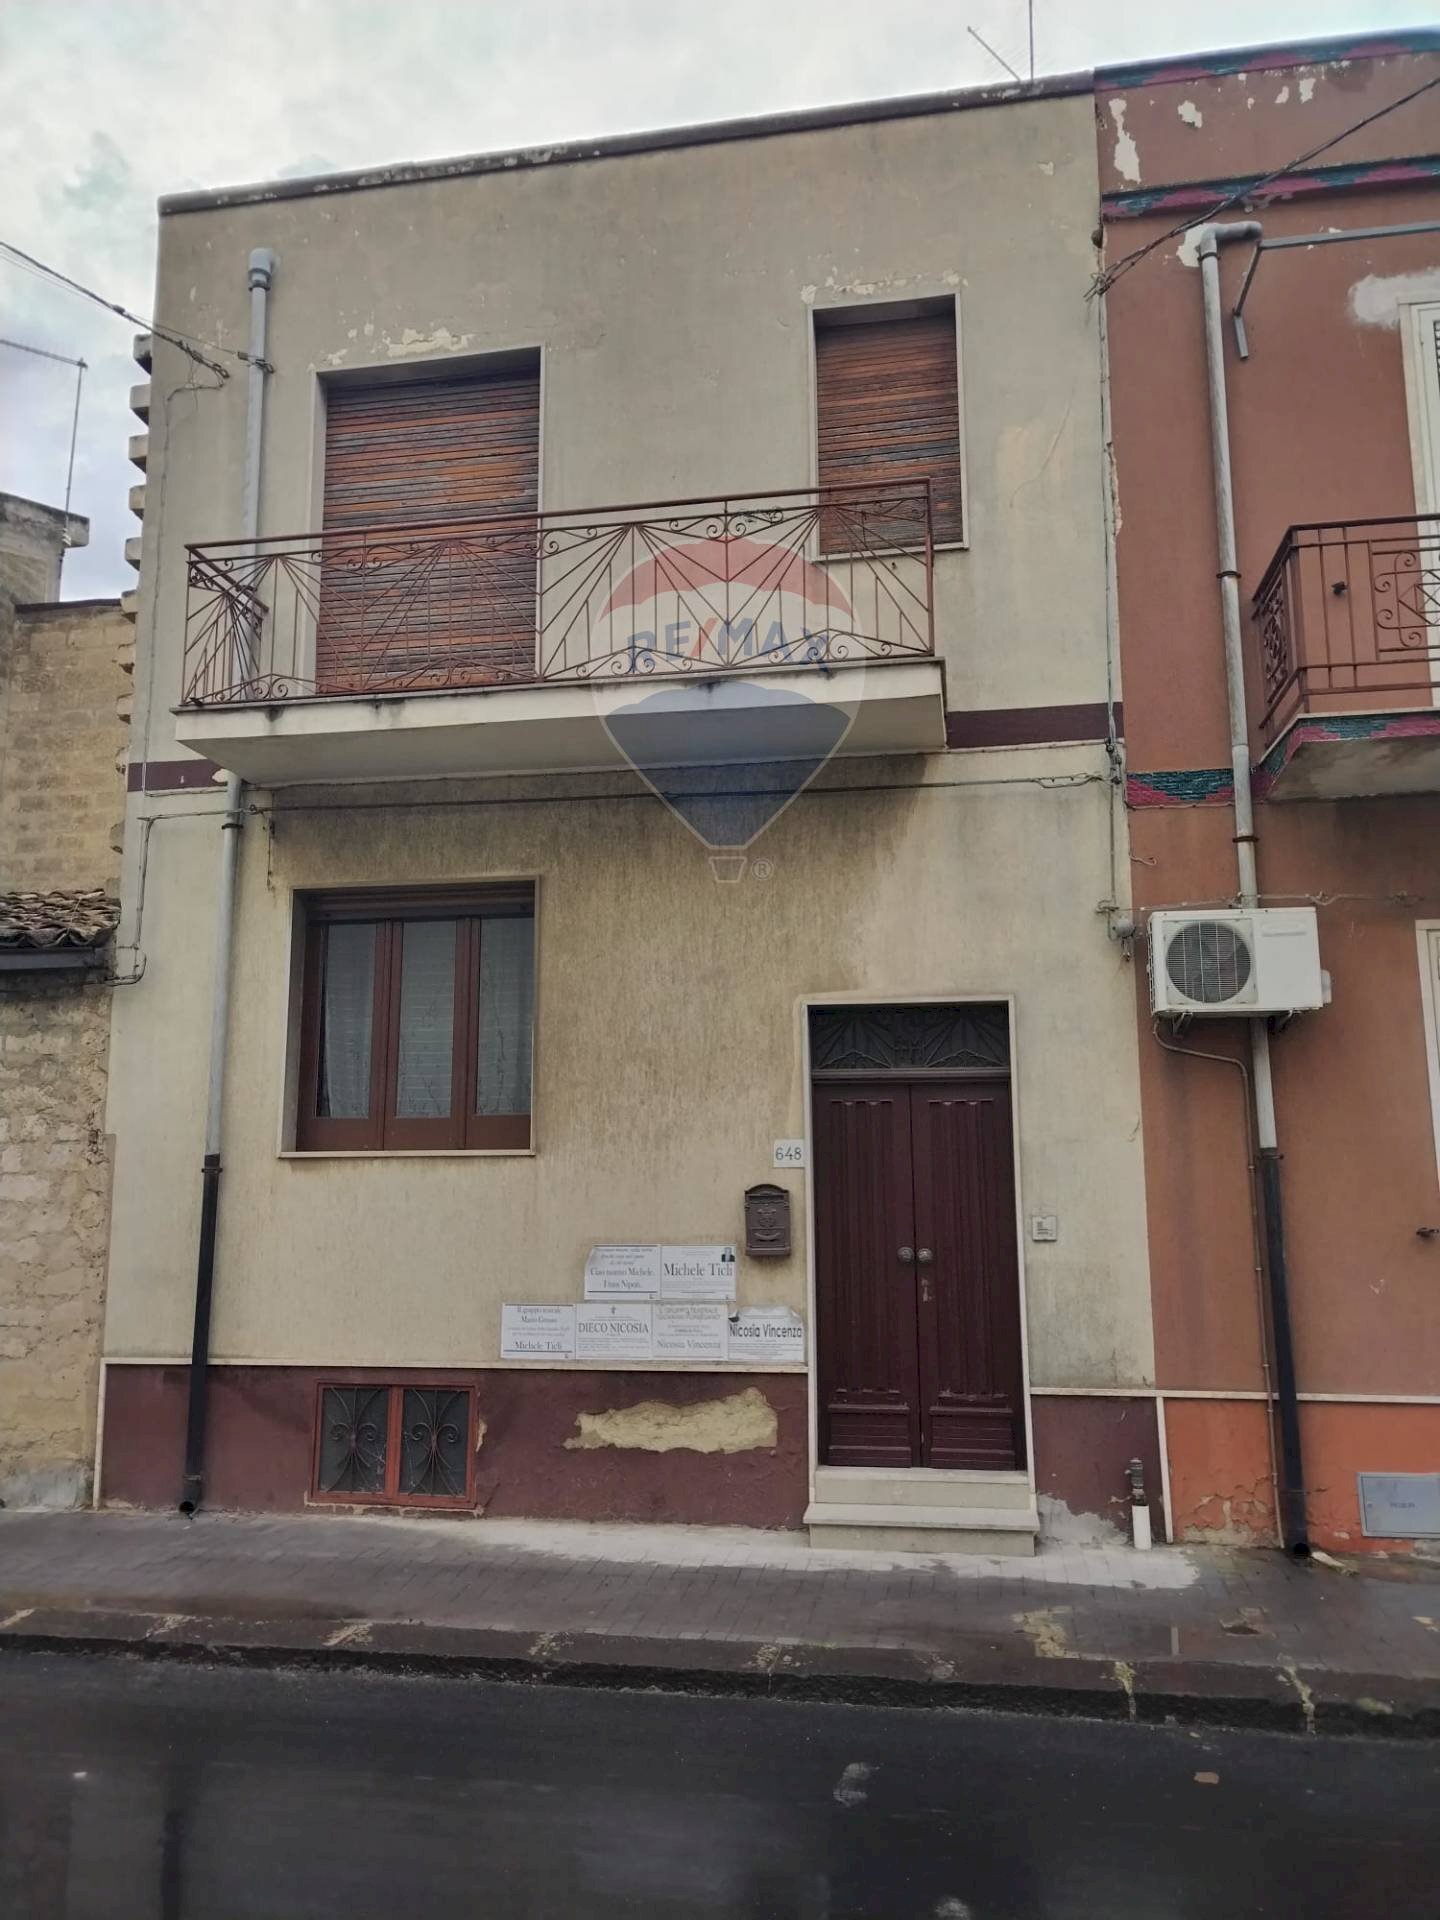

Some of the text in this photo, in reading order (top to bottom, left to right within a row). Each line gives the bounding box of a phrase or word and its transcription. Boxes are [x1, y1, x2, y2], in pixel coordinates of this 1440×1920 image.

[775, 1147, 802, 1161] 648
[664, 1263, 706, 1276] Michele
[609, 1322, 649, 1334] NICOSIA
[729, 1323, 760, 1337] Nicosia
